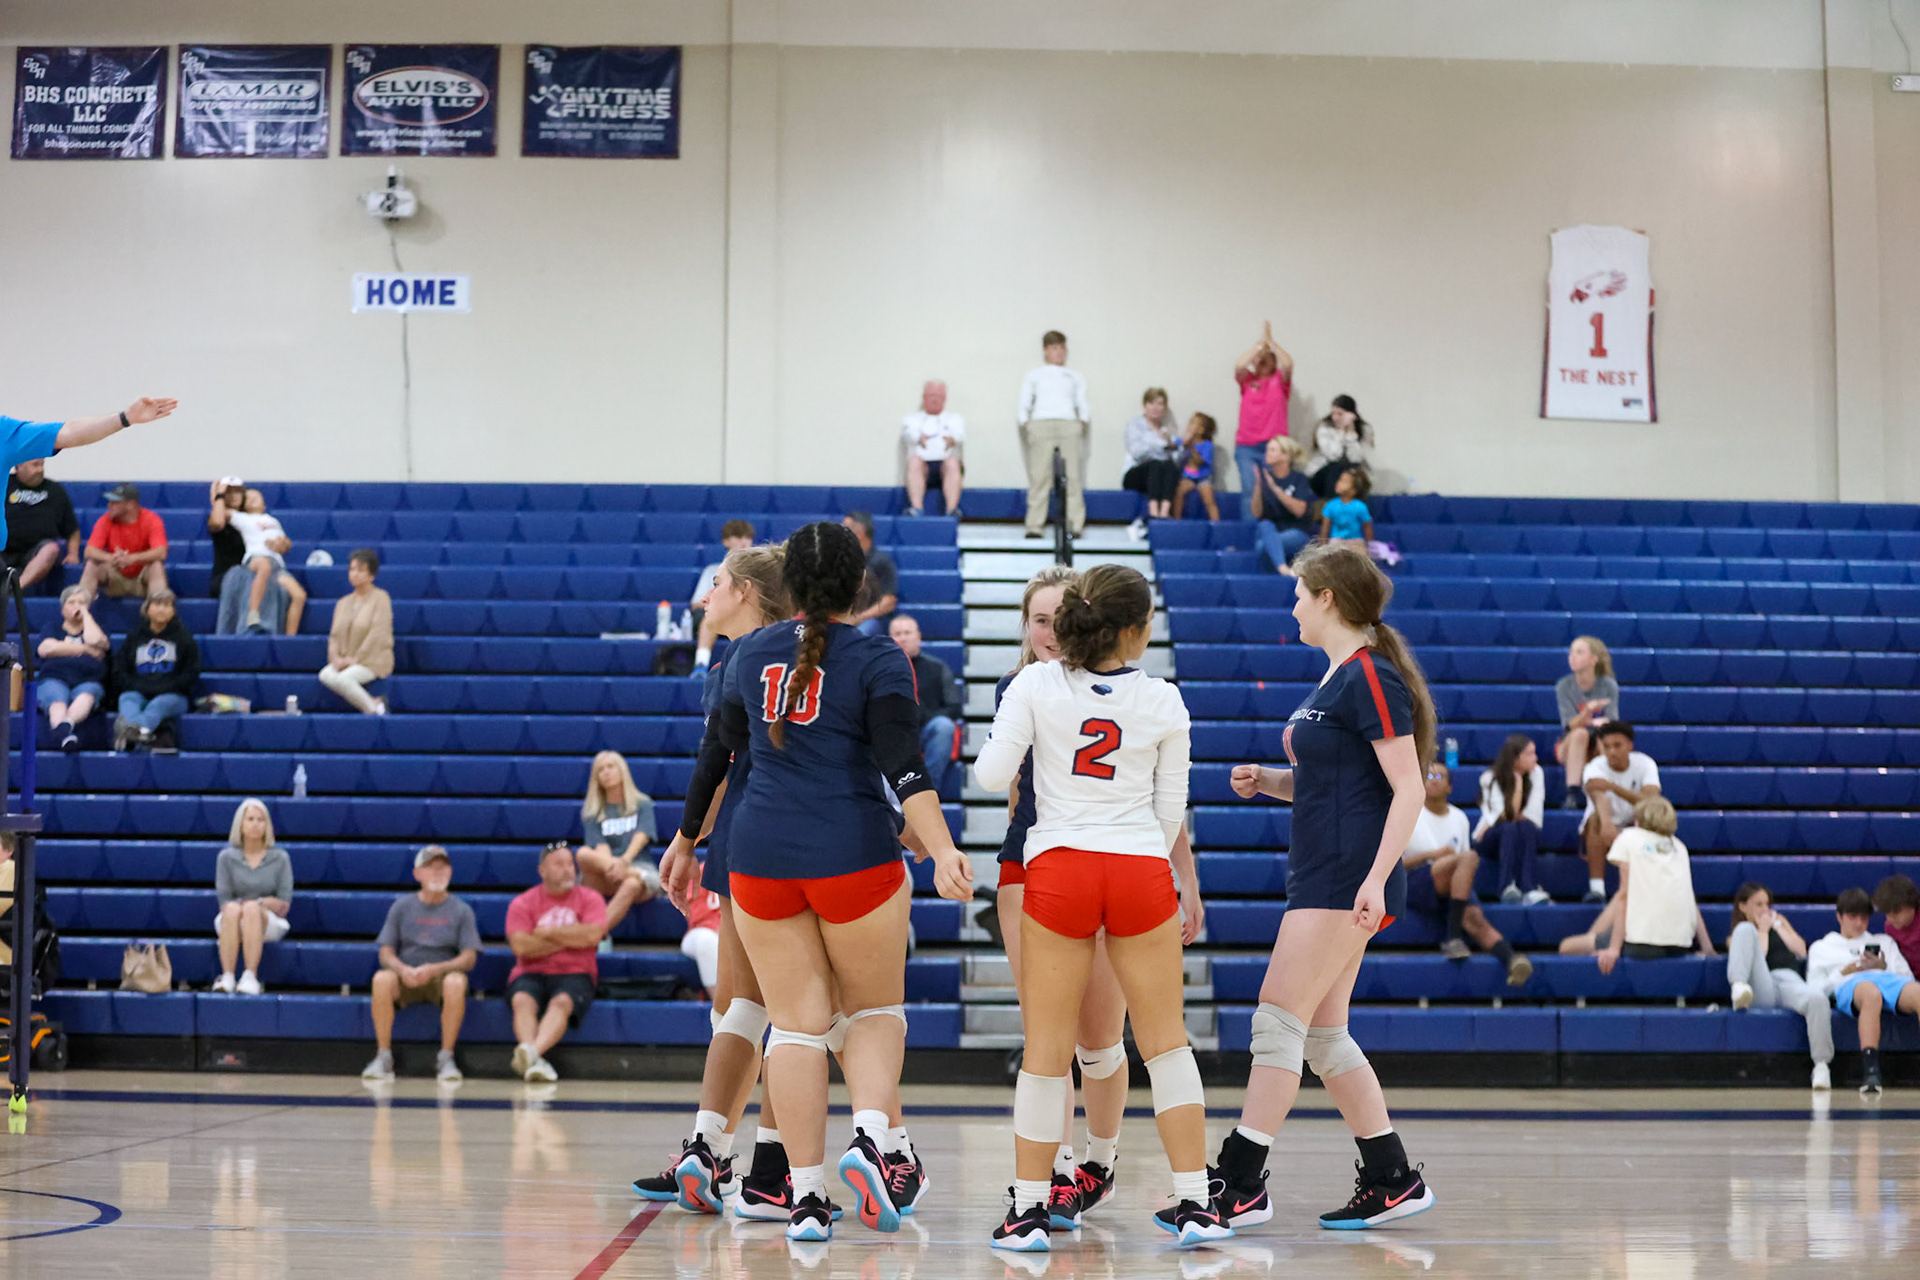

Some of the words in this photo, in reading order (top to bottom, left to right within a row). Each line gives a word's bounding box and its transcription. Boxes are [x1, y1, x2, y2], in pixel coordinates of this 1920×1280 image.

[24, 85, 61, 103] BHS
[65, 84, 157, 104] CONCRETE
[373, 80, 472, 94] ELVIS'S
[559, 86, 671, 105] ANYTIME
[366, 95, 433, 108] AUTOS
[438, 96, 476, 108] LLC
[73, 105, 107, 123] LLC
[562, 104, 671, 119] FITNESS
[28, 123, 46, 134] FOR
[46, 124, 64, 133] ALL
[66, 124, 101, 134] THINGS
[366, 278, 456, 305] HOME
[1589, 312, 1607, 358] 1
[1559, 368, 1589, 384] THE
[1597, 370, 1639, 386] NEST
[760, 662, 826, 726] 10
[1071, 717, 1122, 781] 2
